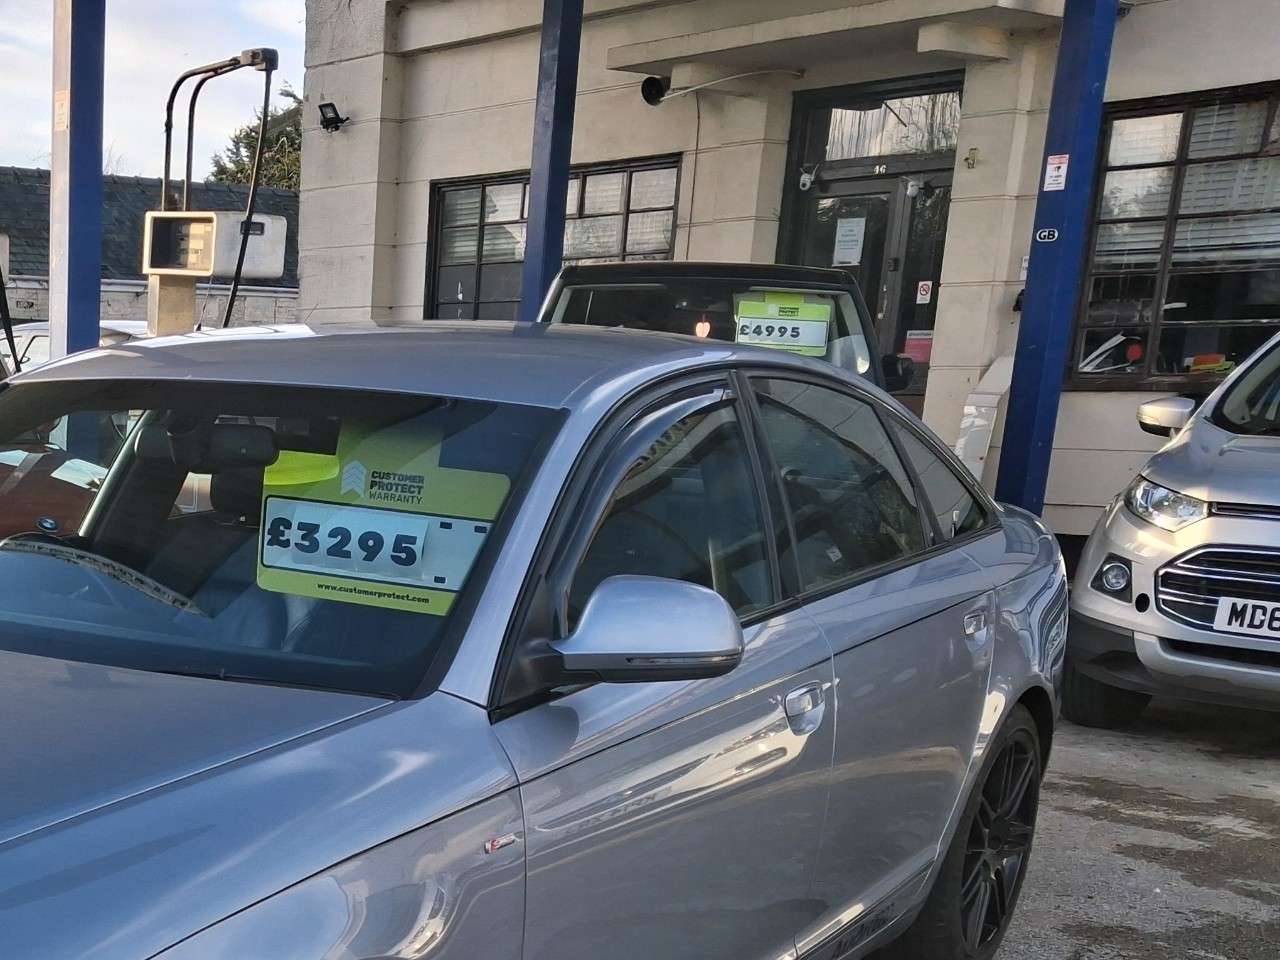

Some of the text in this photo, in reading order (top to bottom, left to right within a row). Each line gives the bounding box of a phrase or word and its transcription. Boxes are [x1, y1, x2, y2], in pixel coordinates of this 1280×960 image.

[1038, 230, 1056, 240] GB
[740, 324, 800, 339] £4995
[371, 470, 425, 484] CUSTOMER
[369, 479, 424, 494] PROTECT
[369, 490, 423, 504] WARRANTY
[267, 517, 418, 567] £3295
[317, 582, 430, 604] www.customerprotect.com
